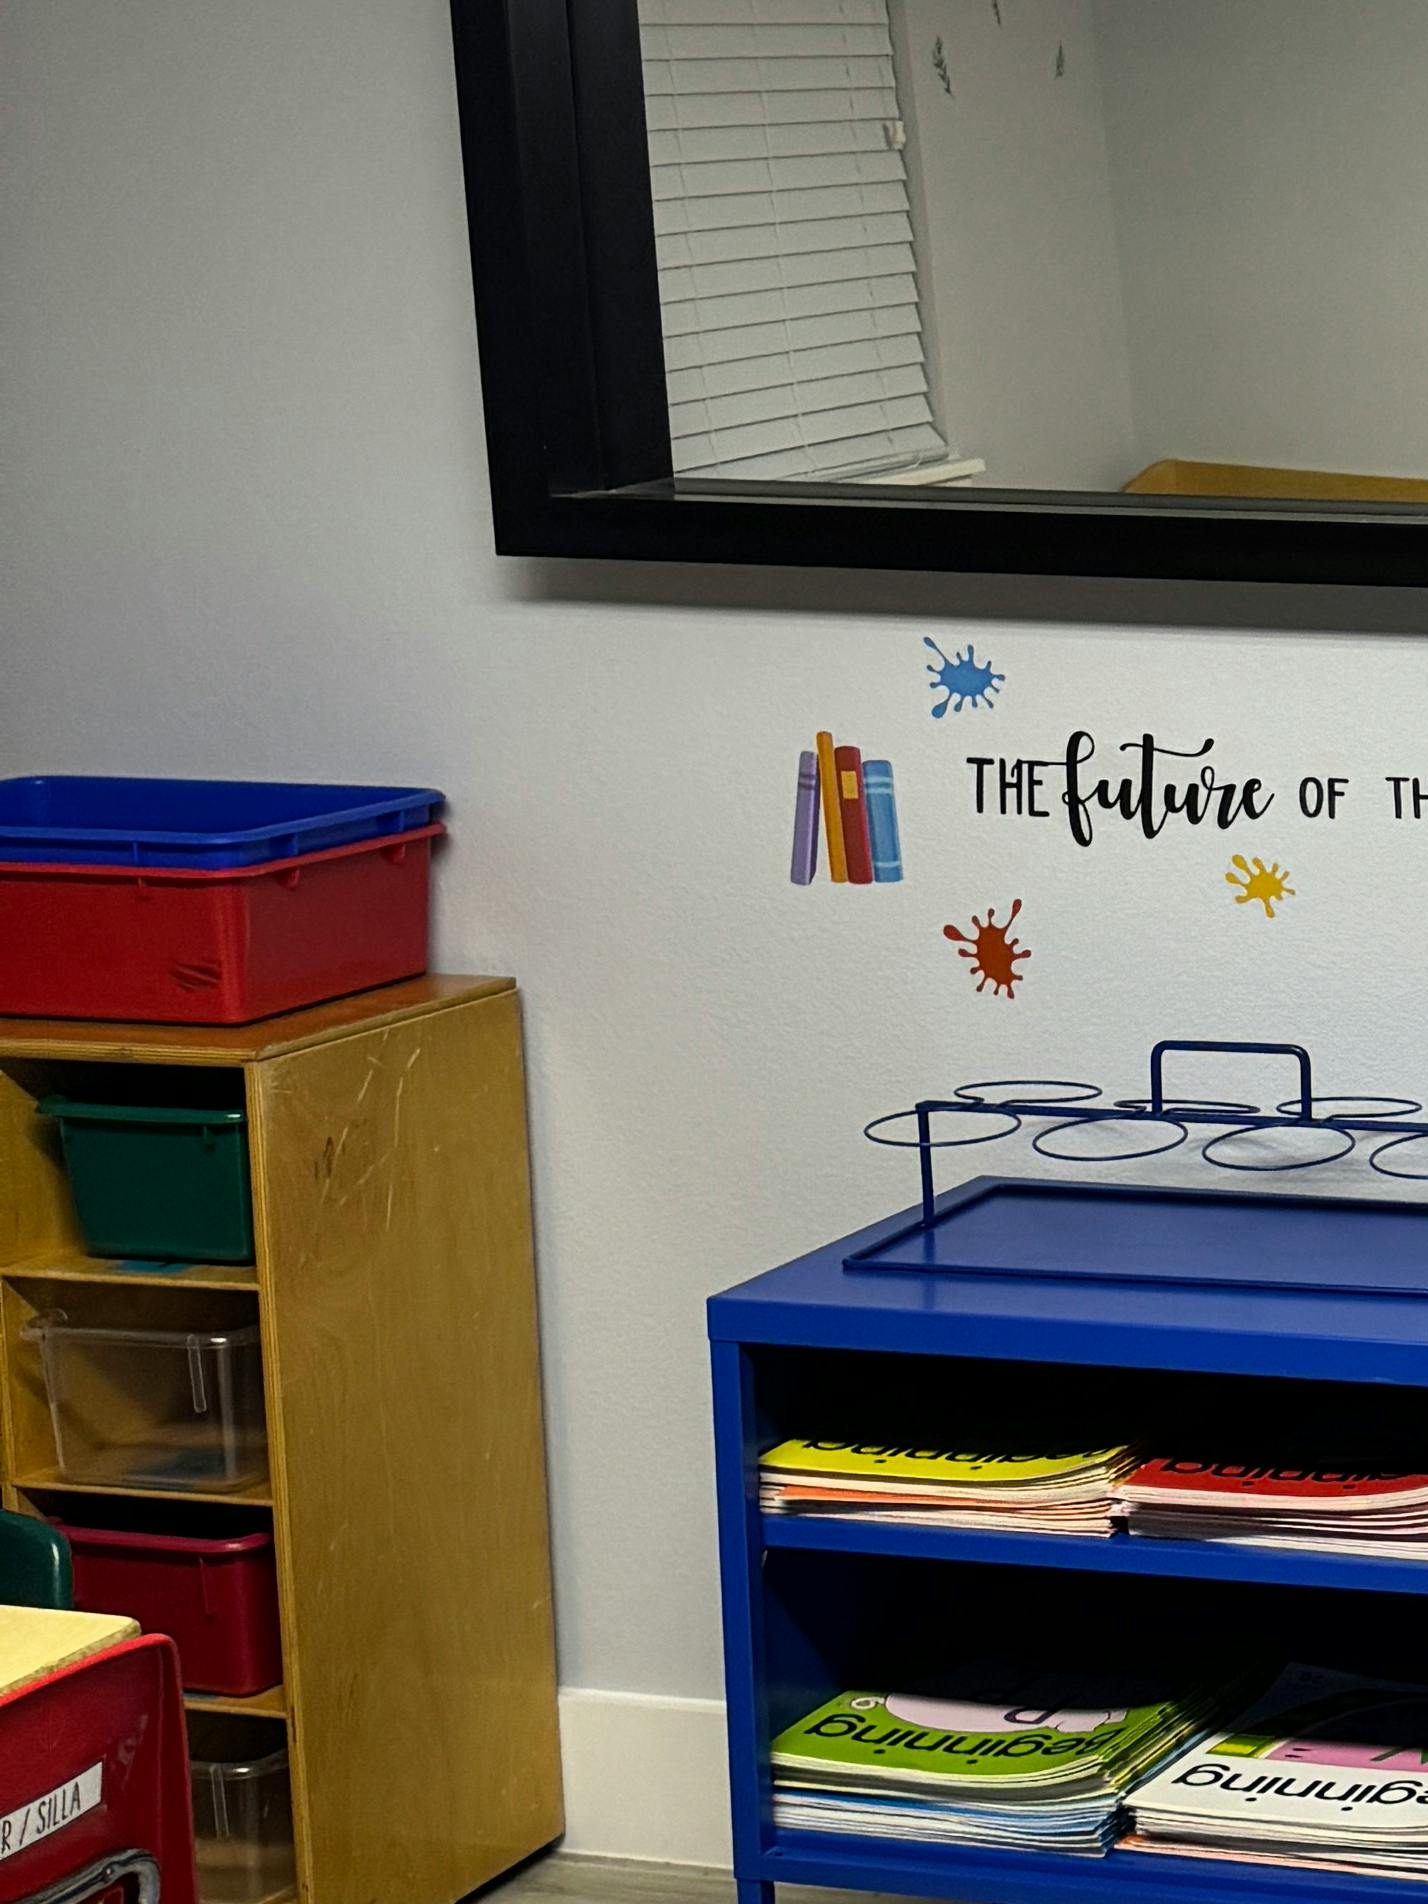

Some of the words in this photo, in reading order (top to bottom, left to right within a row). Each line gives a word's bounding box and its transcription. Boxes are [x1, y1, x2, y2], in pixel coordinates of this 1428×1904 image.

[966, 757, 1050, 817] THE
[1011, 731, 1275, 847] future
[1299, 776, 1350, 820] OF
[36, 1781, 81, 1834] SILLA
